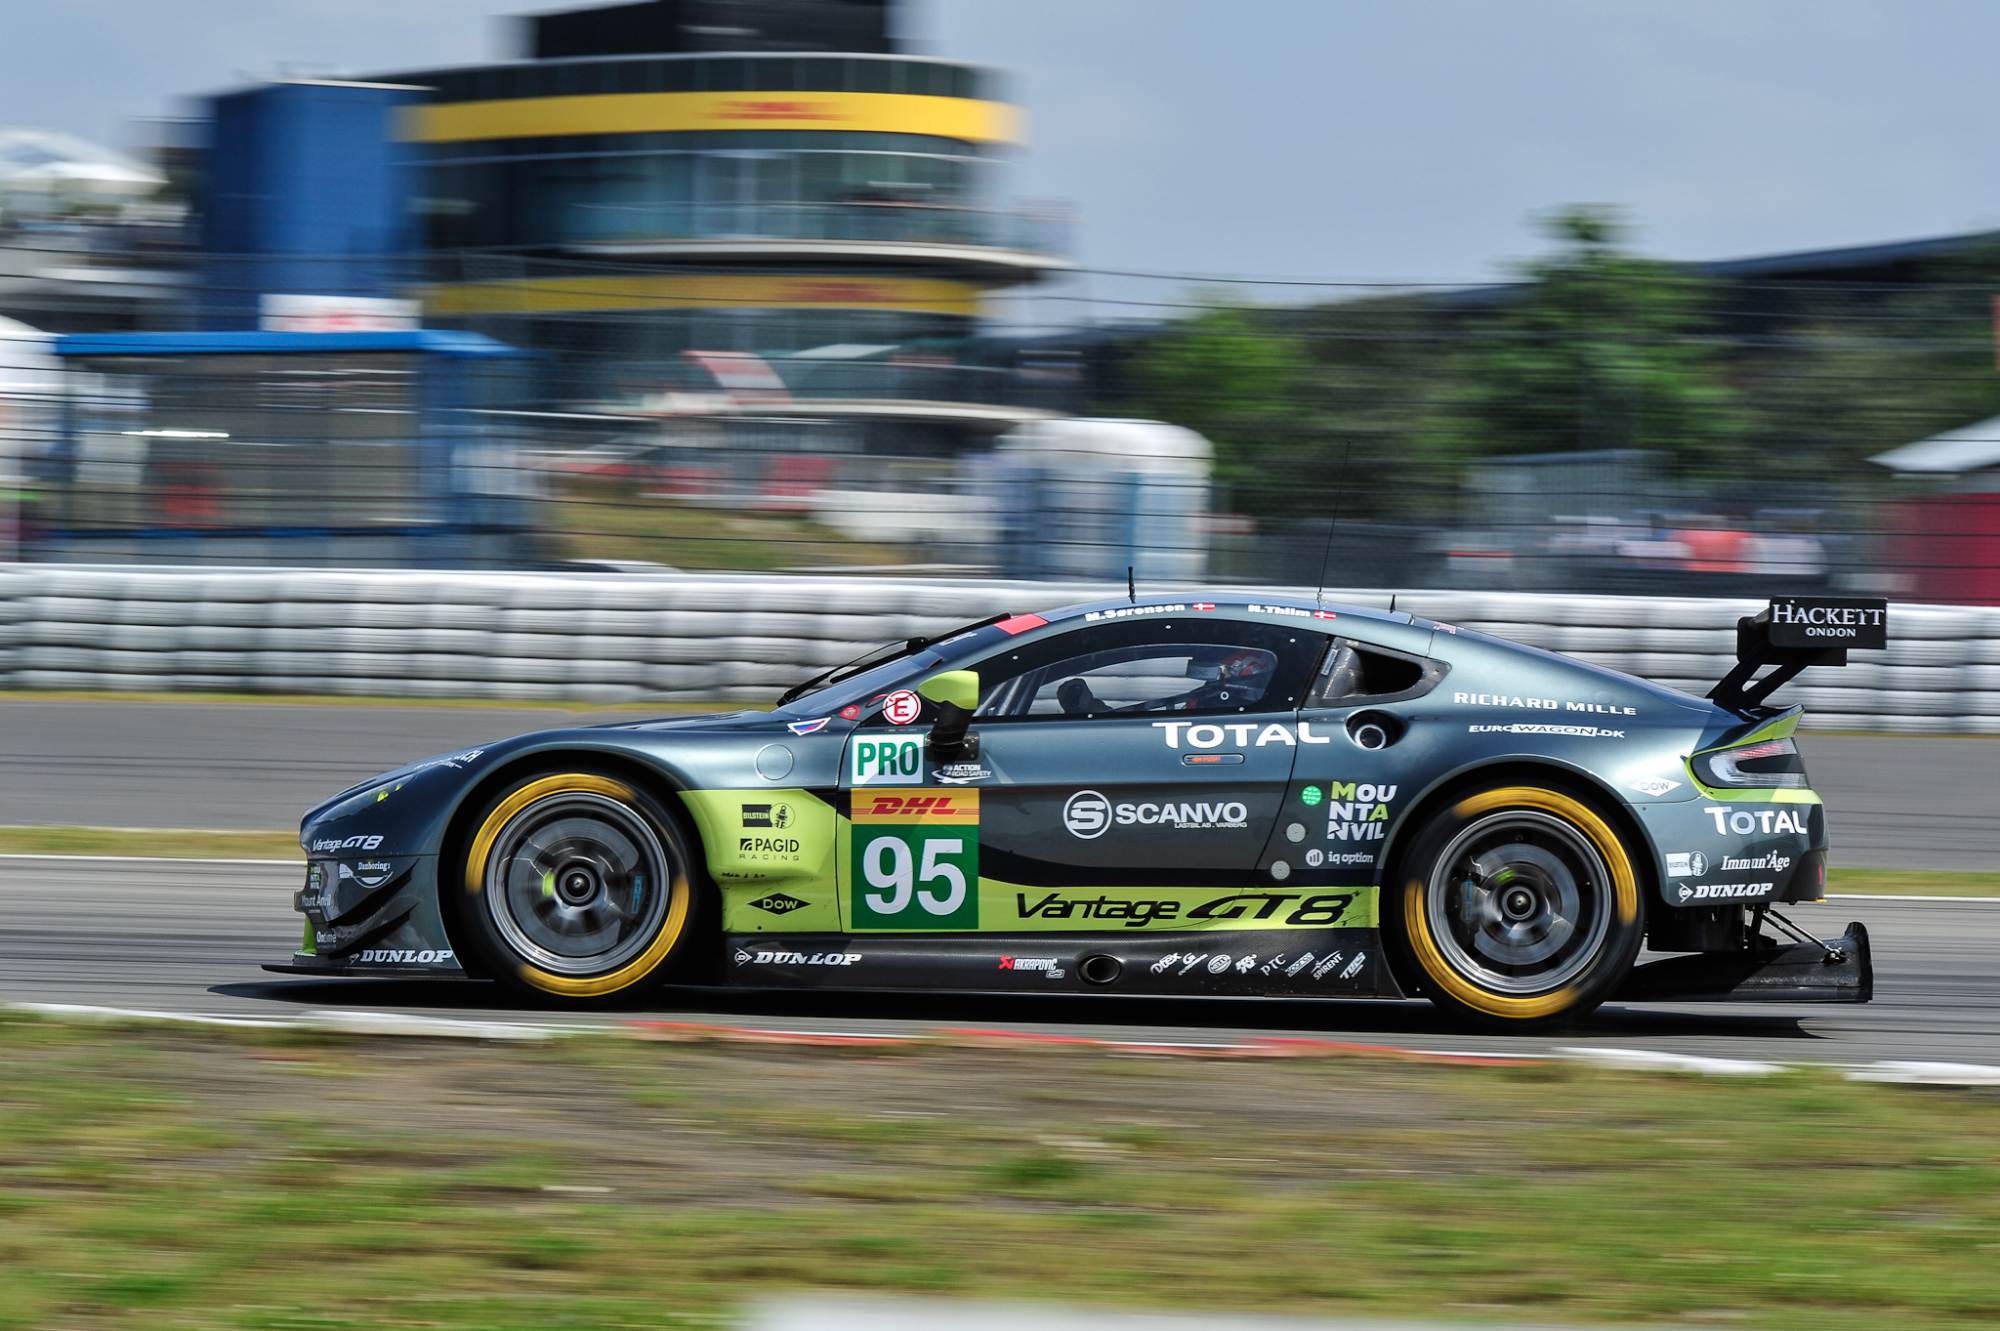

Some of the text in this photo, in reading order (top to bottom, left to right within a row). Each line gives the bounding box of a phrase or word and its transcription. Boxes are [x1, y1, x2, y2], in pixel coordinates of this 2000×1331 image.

[1772, 603, 1885, 626] HACKETT
[1453, 691, 1638, 716] RICHARD MILLE
[1152, 720, 1331, 750] TOTAL
[857, 742, 919, 777] PRO
[1330, 780, 1398, 803] MOU
[871, 796, 957, 816] DHL
[1115, 802, 1249, 825] SCANVO
[1328, 800, 1390, 822] NTA
[1703, 805, 1808, 837] TOTAL
[312, 835, 384, 853] Vantage GT8
[755, 838, 800, 853] PAGID
[738, 853, 800, 862] RACING
[1341, 852, 1374, 865] option
[862, 835, 967, 916] 95
[1692, 882, 1774, 899] DUNLOP
[1016, 893, 1354, 928] Vantage GT8
[359, 949, 455, 963] DUNLOP
[752, 951, 863, 966] DUNLOP
